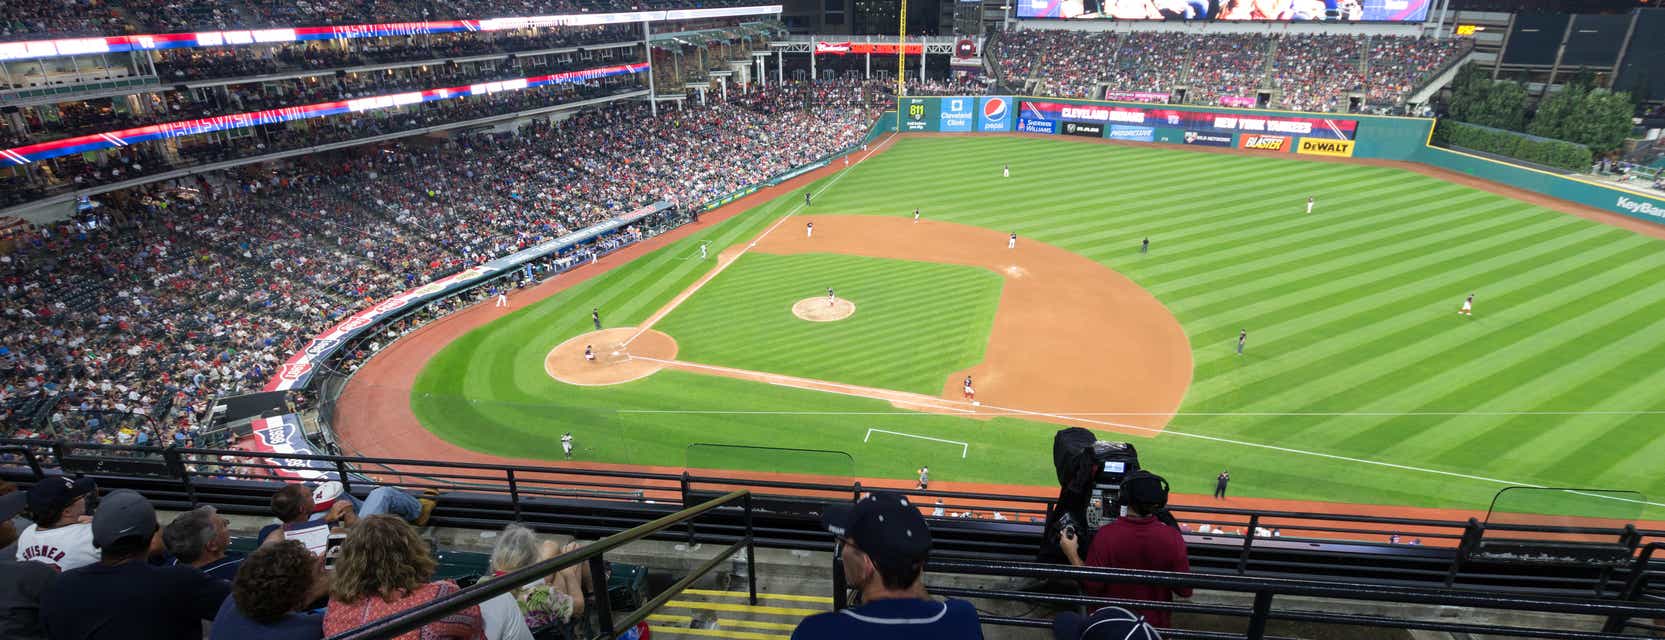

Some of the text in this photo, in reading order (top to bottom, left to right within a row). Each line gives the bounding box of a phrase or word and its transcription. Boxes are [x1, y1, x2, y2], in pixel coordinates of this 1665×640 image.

[1061, 107, 1108, 120] CLEVELAND
[985, 122, 1004, 130] pepsi
[1214, 117, 1313, 133] NEW YORK YANKEES
[1245, 137, 1284, 150] BLASTER
